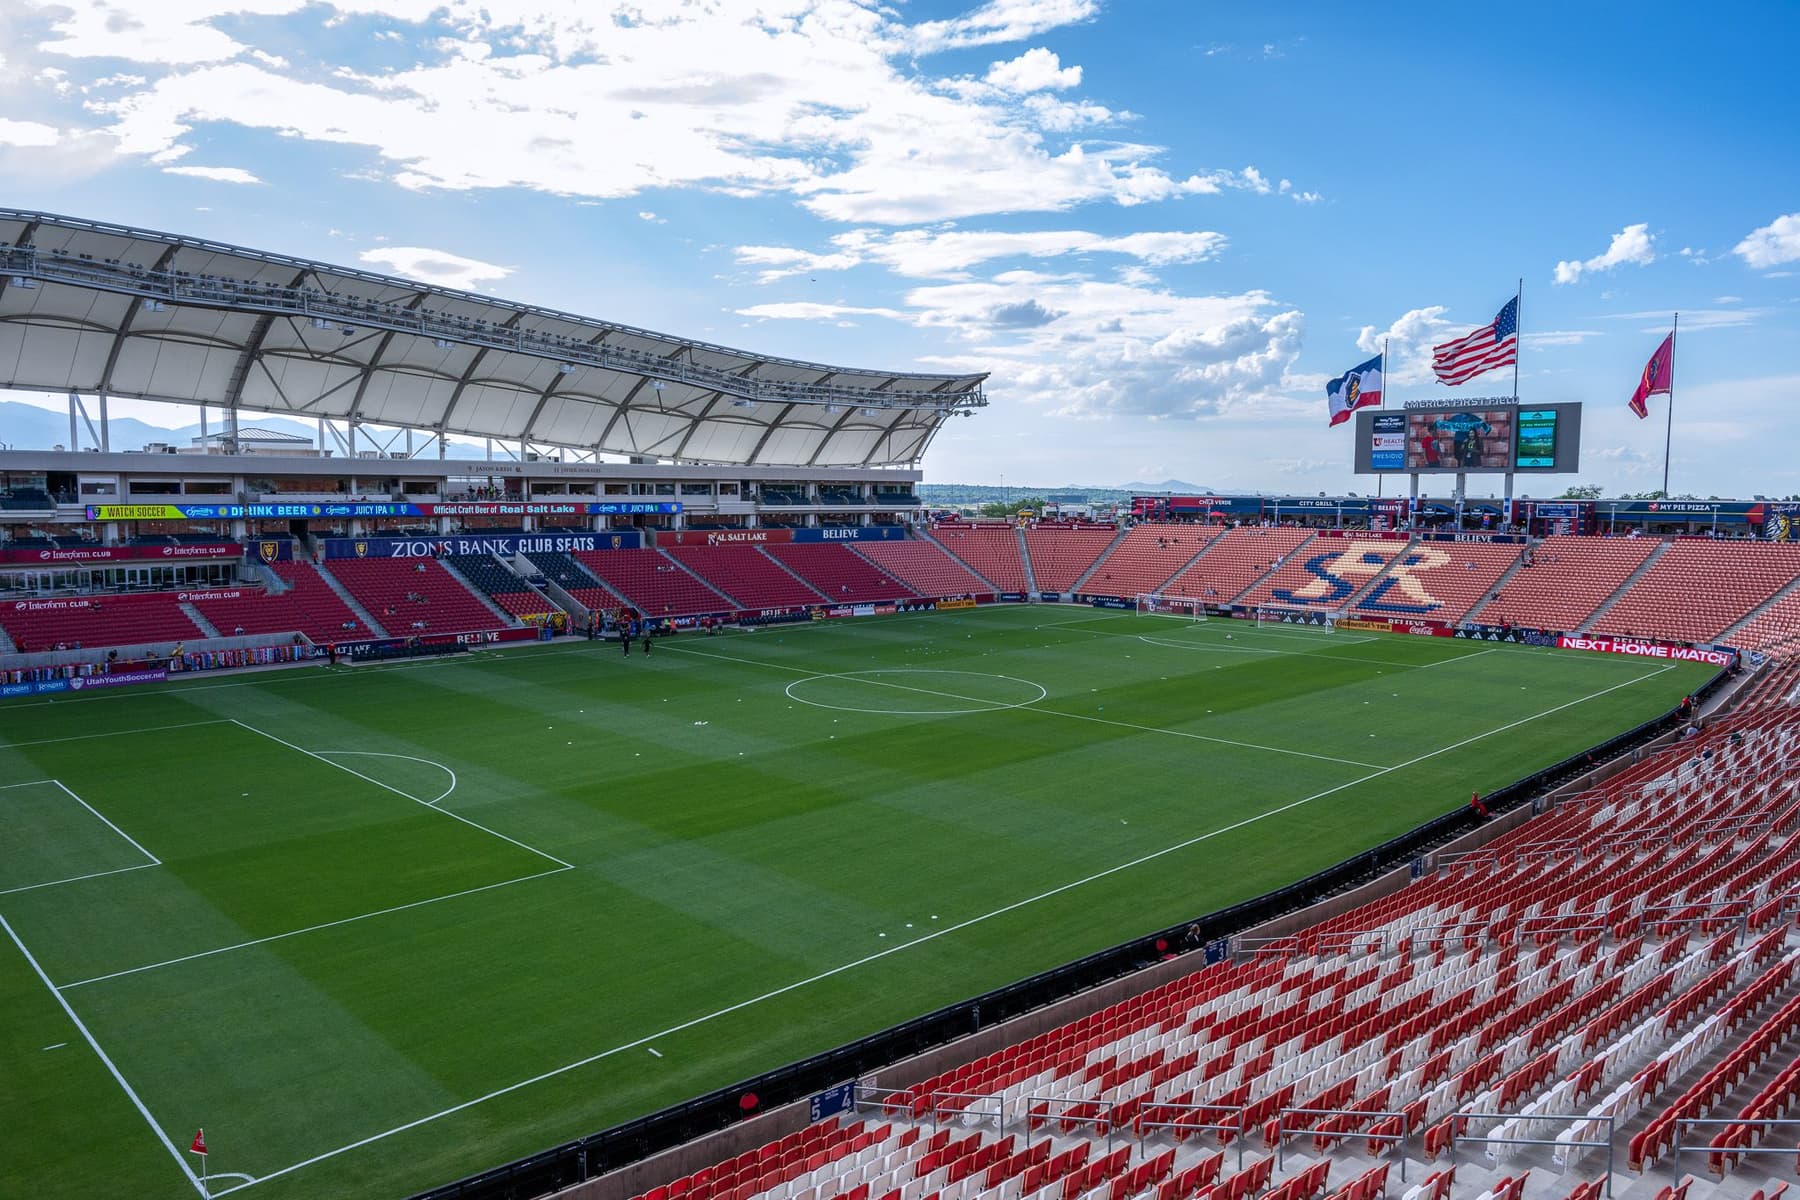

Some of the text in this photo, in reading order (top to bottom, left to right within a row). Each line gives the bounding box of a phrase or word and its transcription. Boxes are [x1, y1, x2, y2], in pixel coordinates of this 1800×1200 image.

[1402, 396, 1519, 409] AMERICA FIRST FIELD
[107, 506, 166, 517] WATCH SOCCER
[231, 506, 307, 517] DRINK BEER
[355, 505, 374, 515] JUICY
[375, 505, 388, 515] IPA
[433, 504, 575, 514] Official Craft Beer of Real Salt Lake
[630, 504, 644, 513] JUICY
[708, 532, 767, 542] RAL SALT LAKE
[823, 528, 859, 539] BELIEVE
[1455, 534, 1493, 543] BELIEVE
[174, 546, 226, 555] Interform CLUB
[391, 536, 594, 558] ZIONS BANK CLUB SEATS
[52, 550, 111, 559] Interform CLUB
[189, 591, 240, 601] Interform CLUB
[28, 600, 89, 610] Interform CLUB
[1336, 620, 1371, 629] Continental
[457, 631, 500, 645] BELIVE
[1563, 637, 1608, 651] NEXT
[1612, 643, 1668, 658] HOME
[1671, 648, 1728, 666] MATCH
[86, 671, 166, 686] UtahYouthSoccer.net
[1218, 947, 1224, 960] 3
[811, 1103, 821, 1121] 5
[841, 1092, 851, 1108] 4
